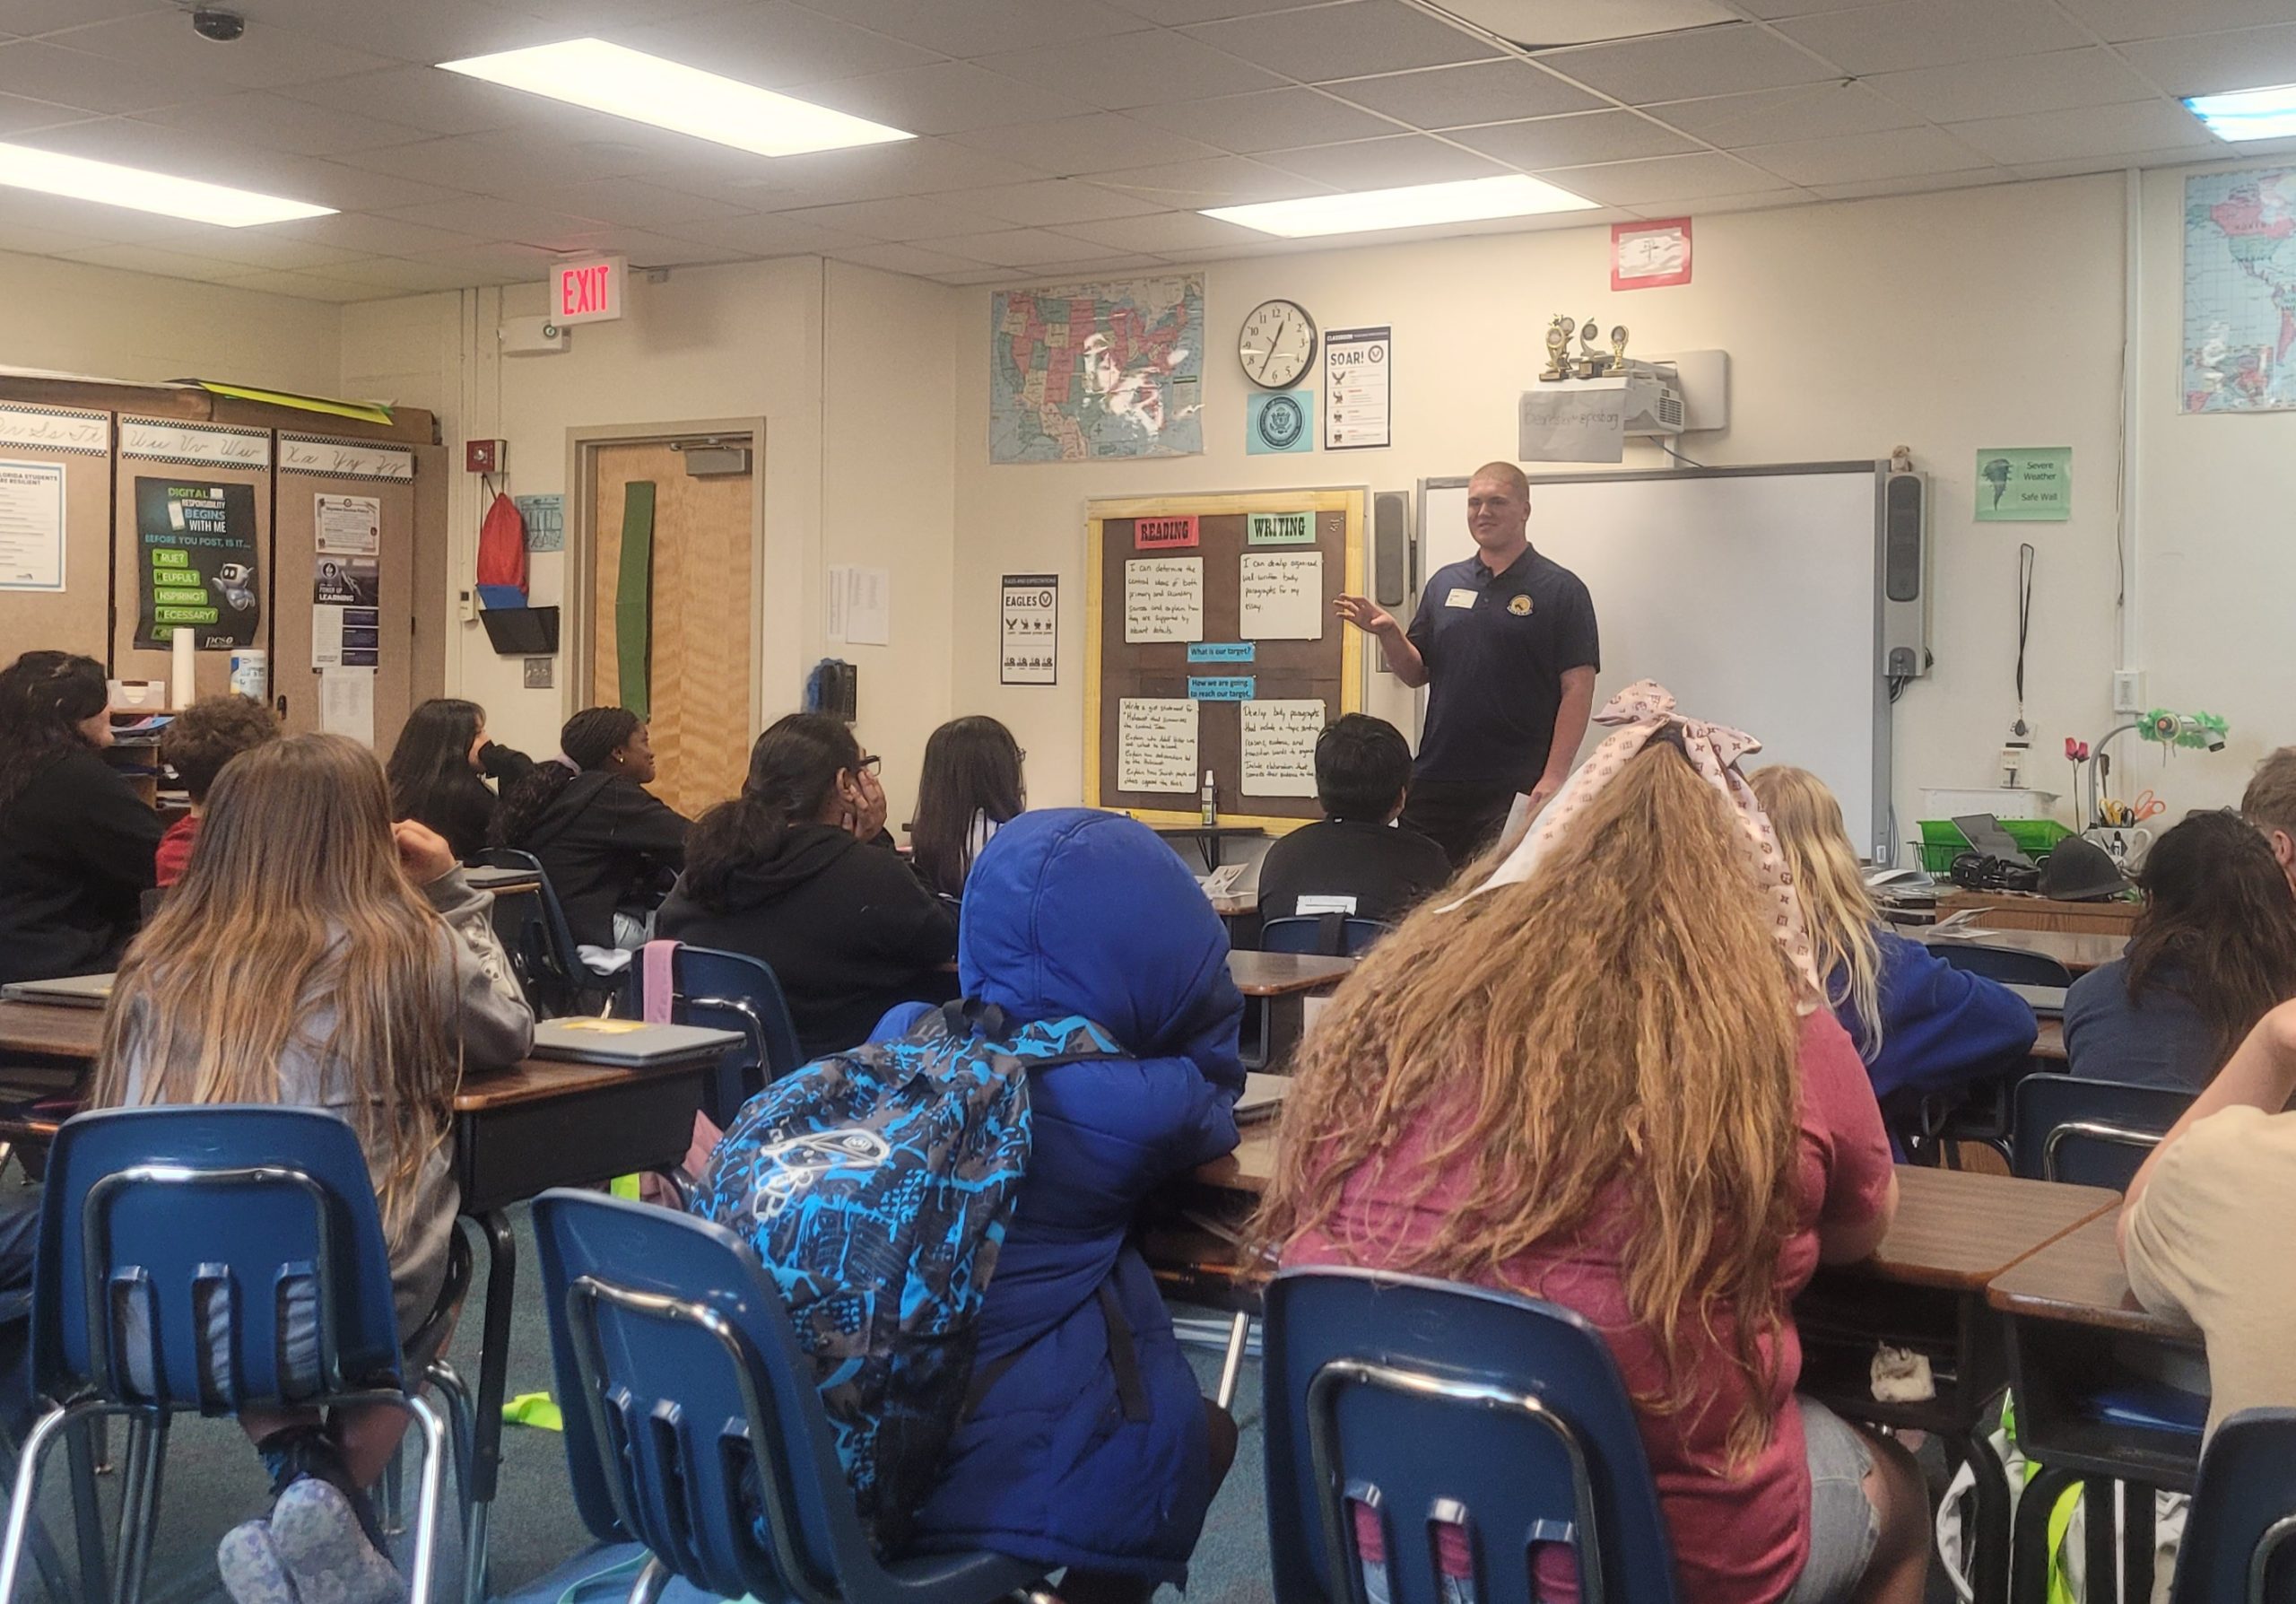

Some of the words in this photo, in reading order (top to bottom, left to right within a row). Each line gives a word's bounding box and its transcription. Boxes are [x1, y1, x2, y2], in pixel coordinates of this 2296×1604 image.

[562, 266, 609, 315] EXIT
[1272, 309, 1281, 318] 12
[1287, 312, 1292, 321] 1
[1259, 315, 1266, 324] 11
[1249, 327, 1258, 336] 10
[1296, 323, 1302, 333] 2
[1330, 350, 1364, 366] SOAR!
[1272, 370, 1278, 379] 6
[2027, 461, 2054, 470] Severe
[24, 473, 57, 481] STUDENTS
[2023, 473, 2057, 481] Weather
[168, 487, 208, 499] DIGITAL
[2022, 493, 2039, 501] Safe
[181, 499, 226, 509] RESPONSIBILITY
[185, 509, 226, 520] BEGINS
[188, 519, 212, 532] WITH
[213, 520, 226, 533] ME
[1141, 520, 1188, 541] READING
[1254, 517, 1306, 537] WRITING
[144, 534, 177, 544] BEFORE
[178, 536, 197, 545] YOU
[199, 537, 224, 548] POST,
[157, 554, 184, 563] TRUE?
[1156, 563, 1182, 572] determine
[1187, 565, 1196, 573] the
[157, 571, 196, 582] HELPFUL?
[157, 588, 205, 601] INSPIRING?
[318, 594, 354, 602] LEARNING
[1129, 591, 1151, 600] primary
[1005, 596, 1037, 606] EAGLES
[158, 608, 215, 620] NECESSARY?
[205, 636, 234, 648] pcso
[1191, 648, 1207, 656] What
[1227, 647, 1251, 656] target?
[1230, 680, 1248, 688] going
[1243, 705, 1266, 720] Develop
